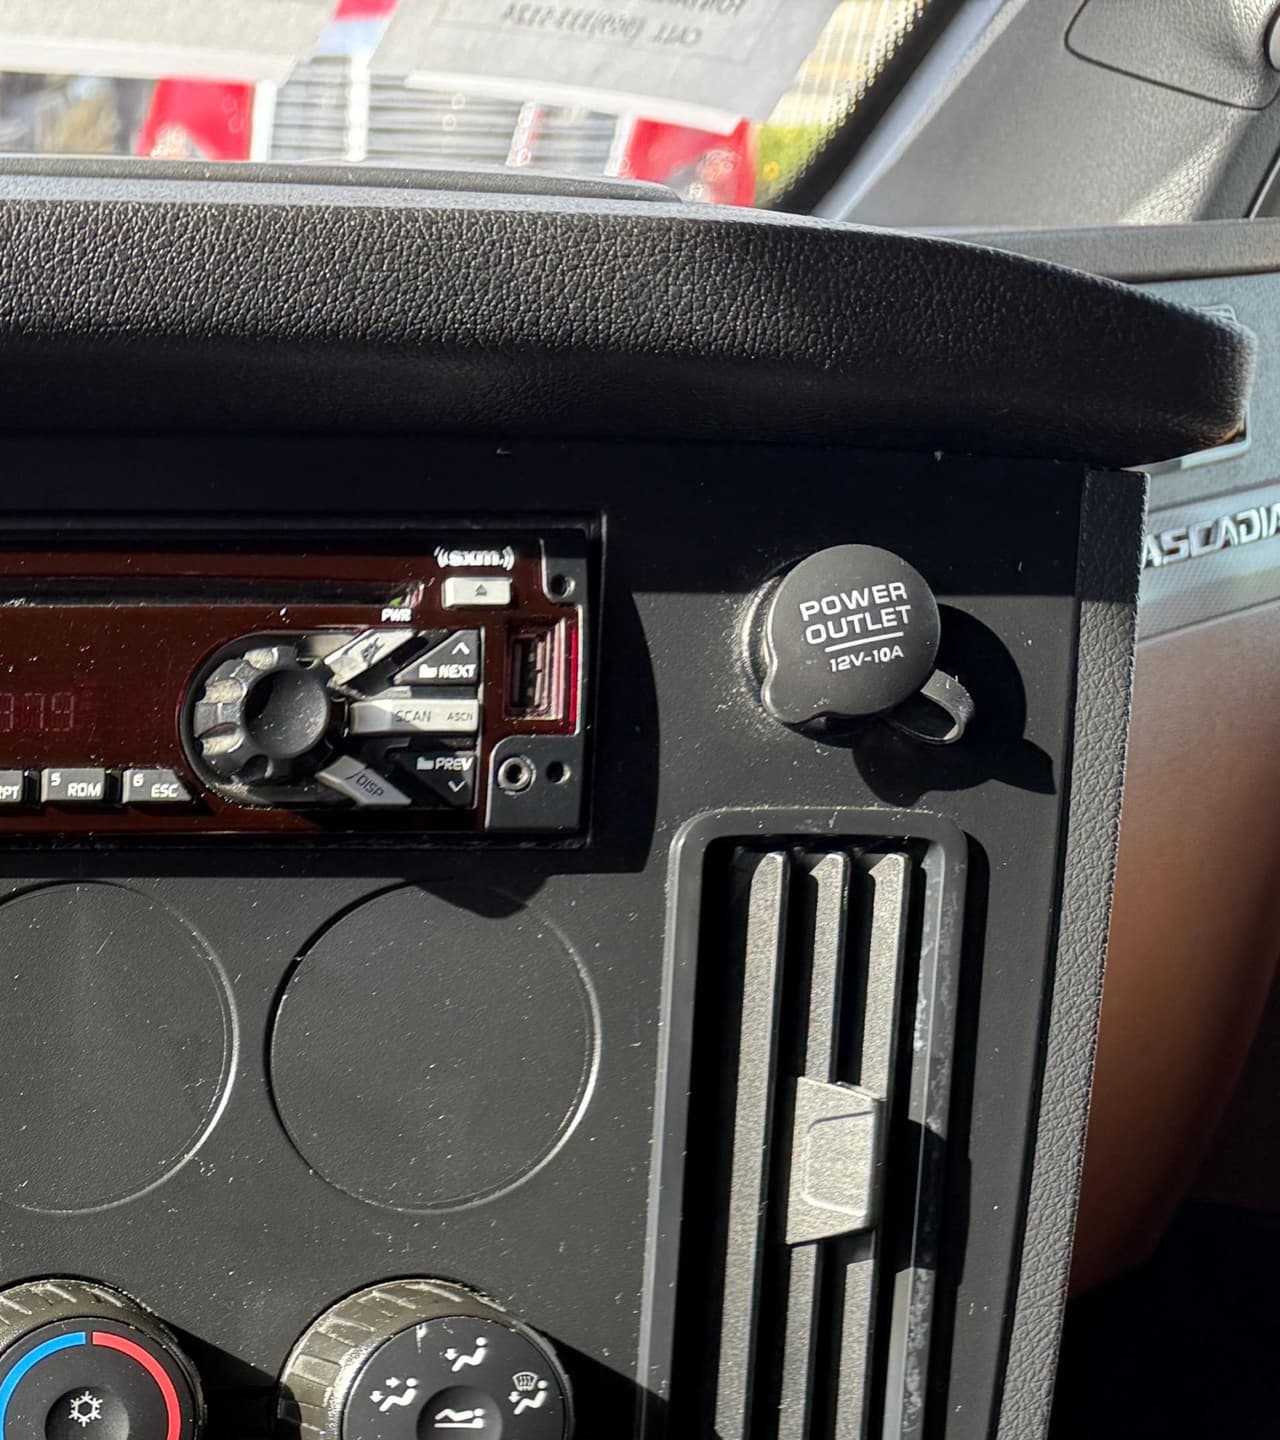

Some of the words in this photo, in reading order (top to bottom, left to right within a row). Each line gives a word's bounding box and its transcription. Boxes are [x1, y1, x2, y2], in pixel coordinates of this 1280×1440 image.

[799, 581, 907, 621] POWER
[381, 608, 413, 622] PWR
[805, 605, 911, 645] OUTLET
[438, 663, 476, 678] NEXT
[830, 646, 904, 672] 12V-10A
[394, 711, 432, 722] SCAN
[446, 712, 473, 721] ASCN
[435, 757, 473, 771] PREV
[51, 773, 61, 786] 5
[67, 782, 101, 797] RDM
[133, 772, 143, 787] 6
[151, 783, 178, 797] ESC
[355, 772, 385, 798] DISP
